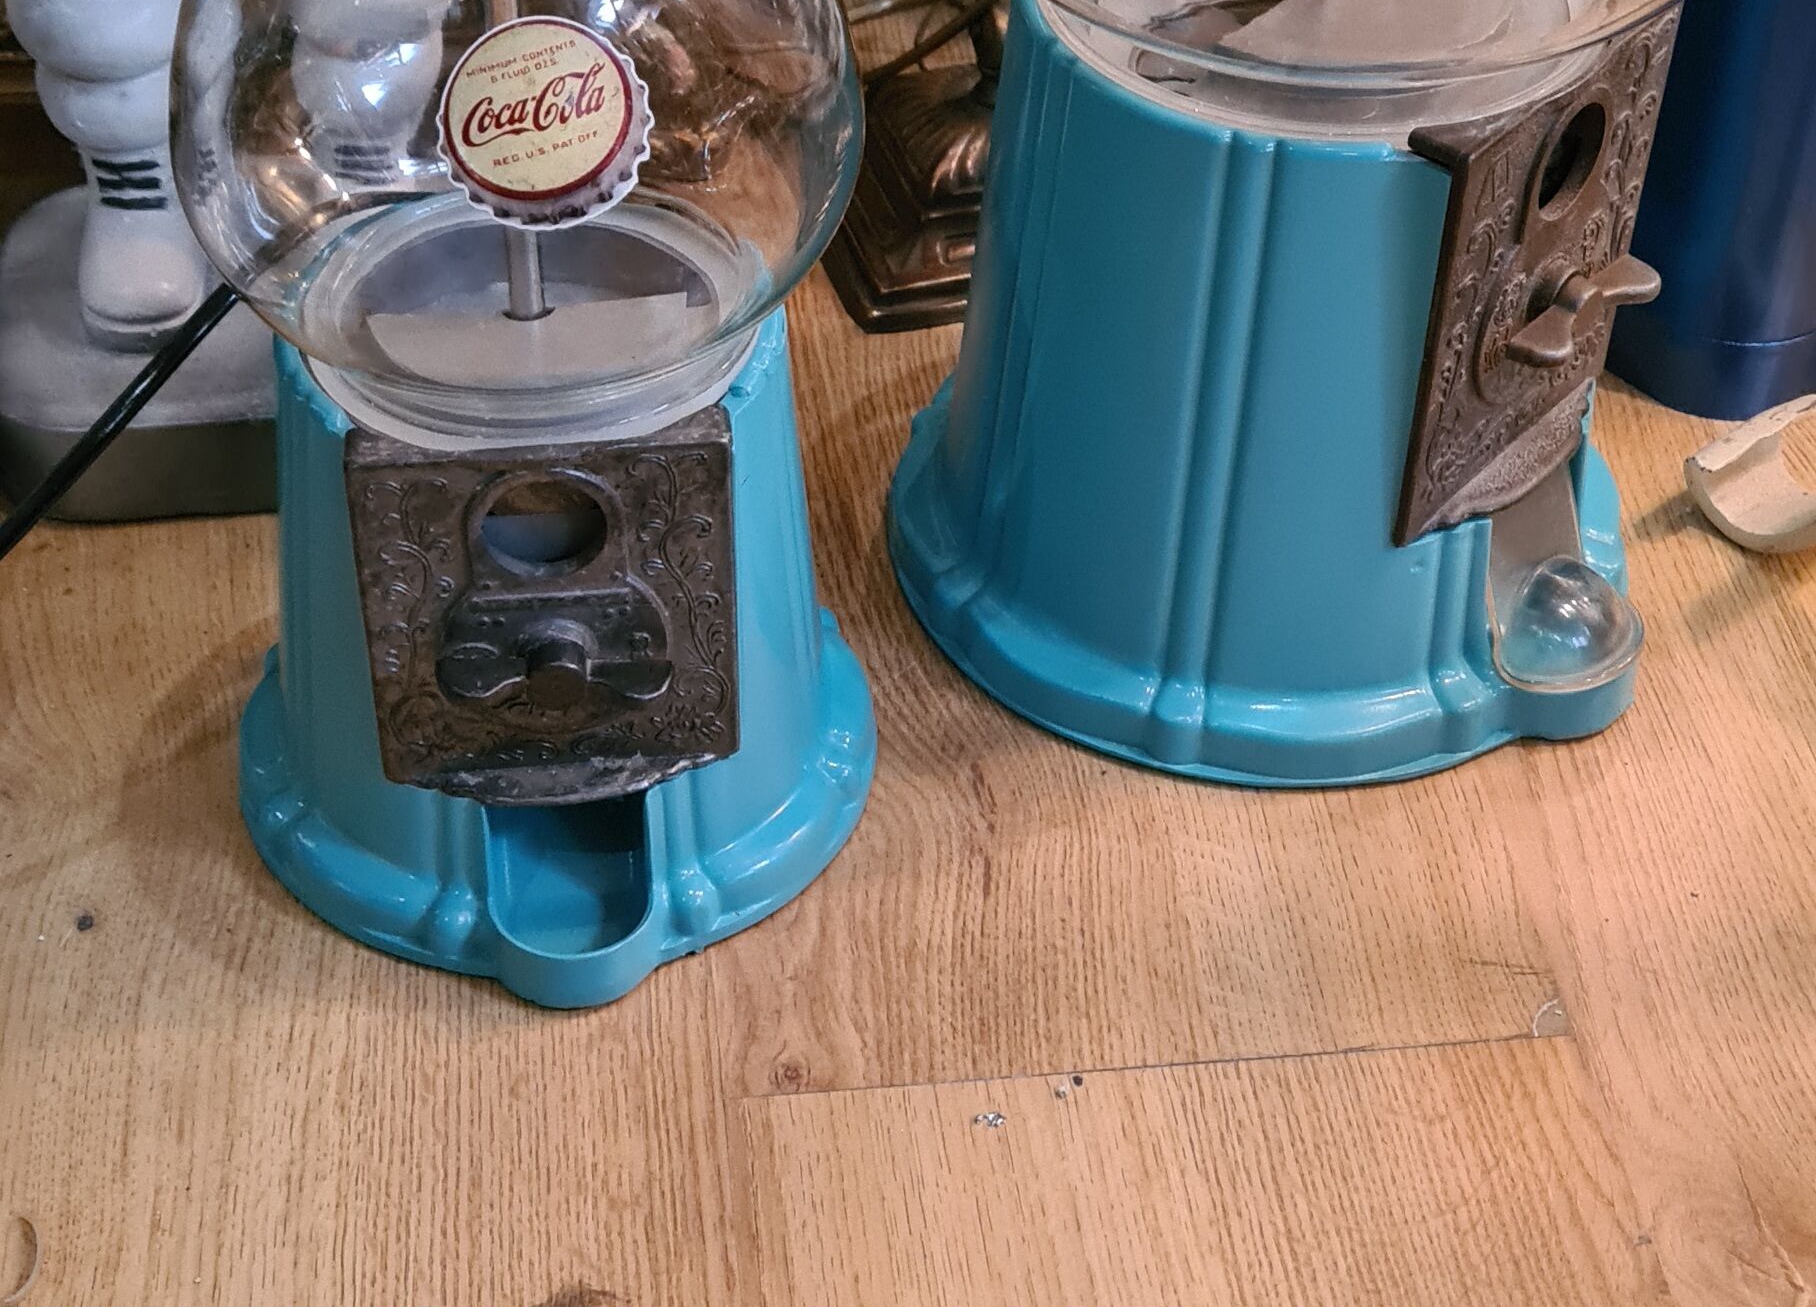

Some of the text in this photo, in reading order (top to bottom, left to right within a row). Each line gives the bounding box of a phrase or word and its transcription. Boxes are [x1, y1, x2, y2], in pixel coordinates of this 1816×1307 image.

[465, 39, 577, 78] MINIMUM CONTENTS
[501, 65, 531, 80] FLUID
[462, 62, 606, 147] Coca-Cola
